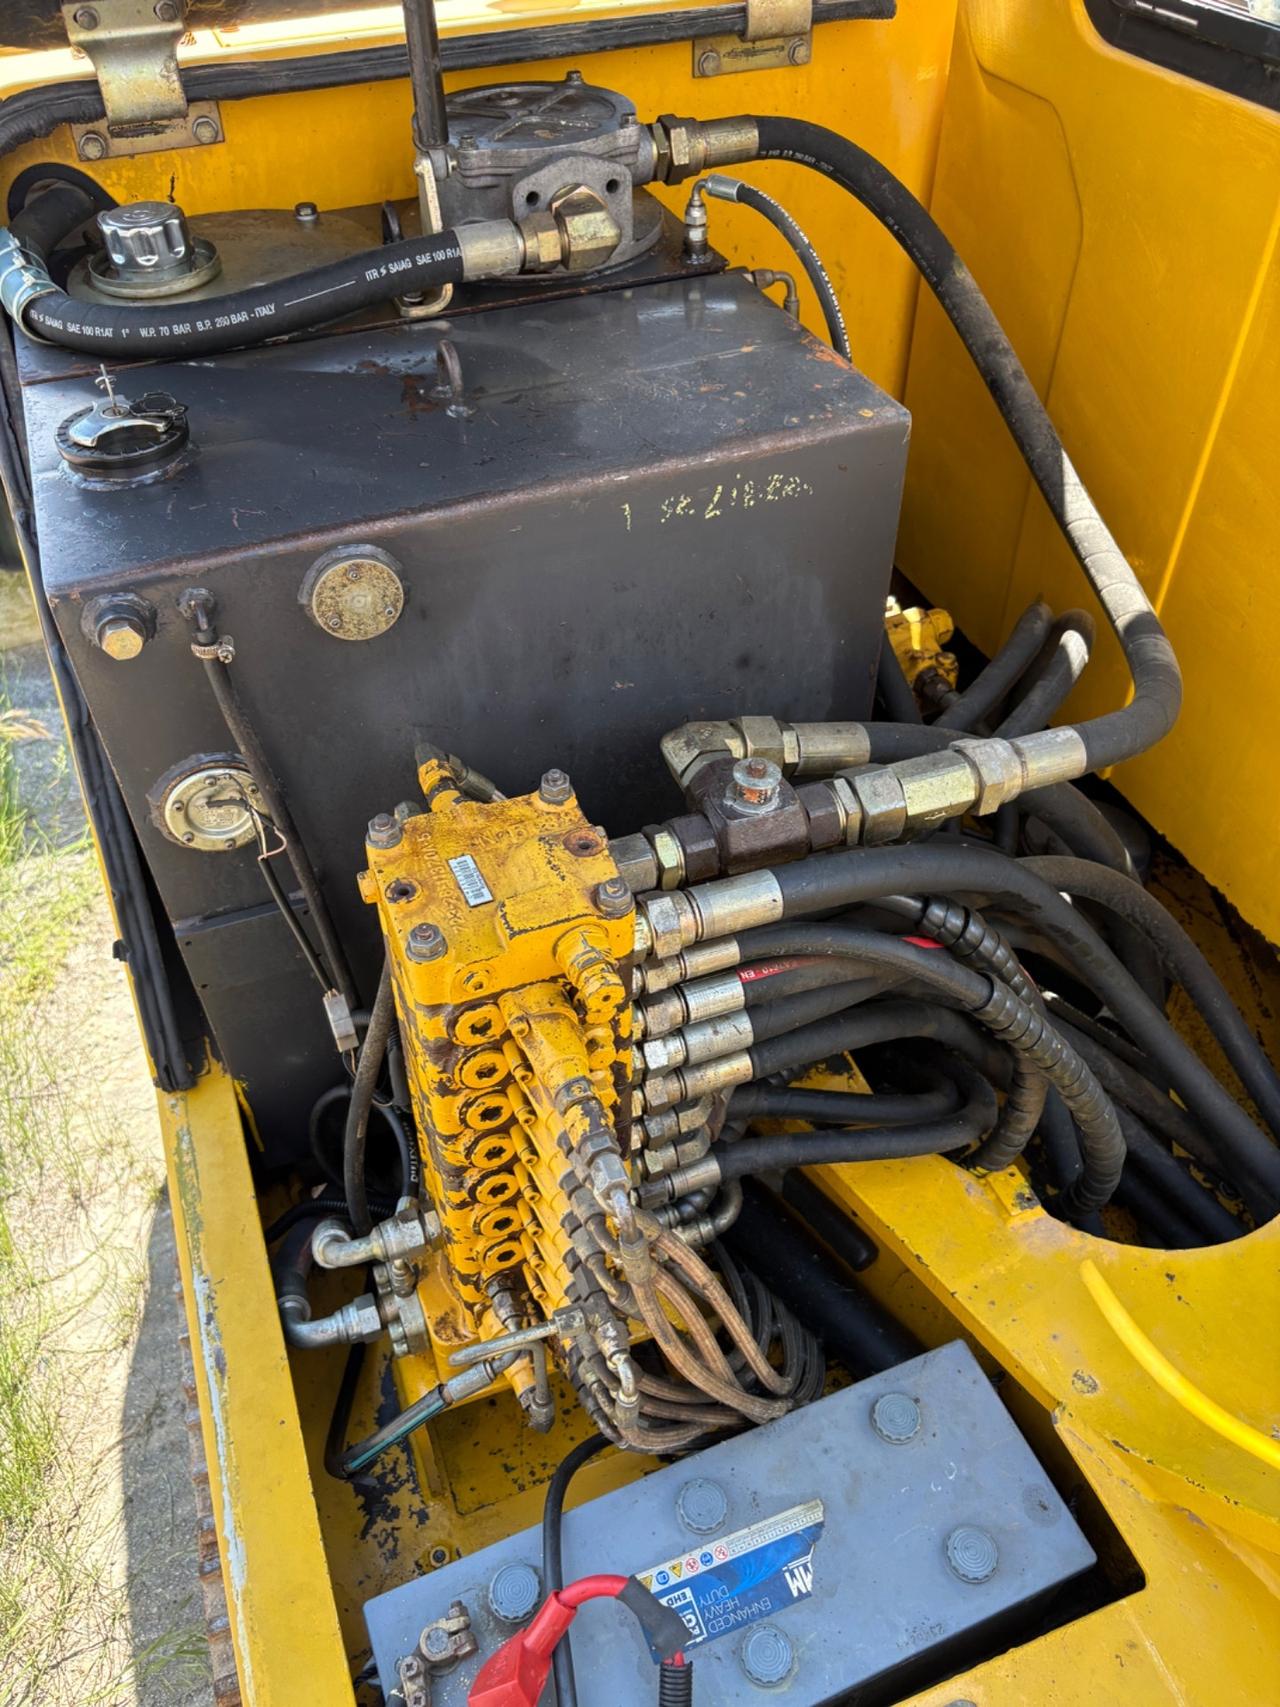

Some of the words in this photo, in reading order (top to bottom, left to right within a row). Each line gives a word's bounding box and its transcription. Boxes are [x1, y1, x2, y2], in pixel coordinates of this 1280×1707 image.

[365, 268, 380, 282] ITR
[387, 258, 413, 274] SAIAG
[415, 252, 432, 266] SAE
[432, 249, 446, 262] 100
[66, 322, 81, 334] SAE
[81, 325, 94, 336] 100
[95, 327, 114, 338] R1AT
[139, 327, 157, 338] W.P.
[159, 326, 170, 336] 70
[172, 322, 192, 335] BAR
[195, 320, 213, 332] B.P.
[230, 310, 250, 325] BAR
[254, 303, 276, 318] ITALY
[666, 1591, 689, 1606] EHD
[700, 1585, 730, 1608] DUTY
[704, 1596, 741, 1620] HEAVY
[708, 1596, 773, 1634] ENHANCED
